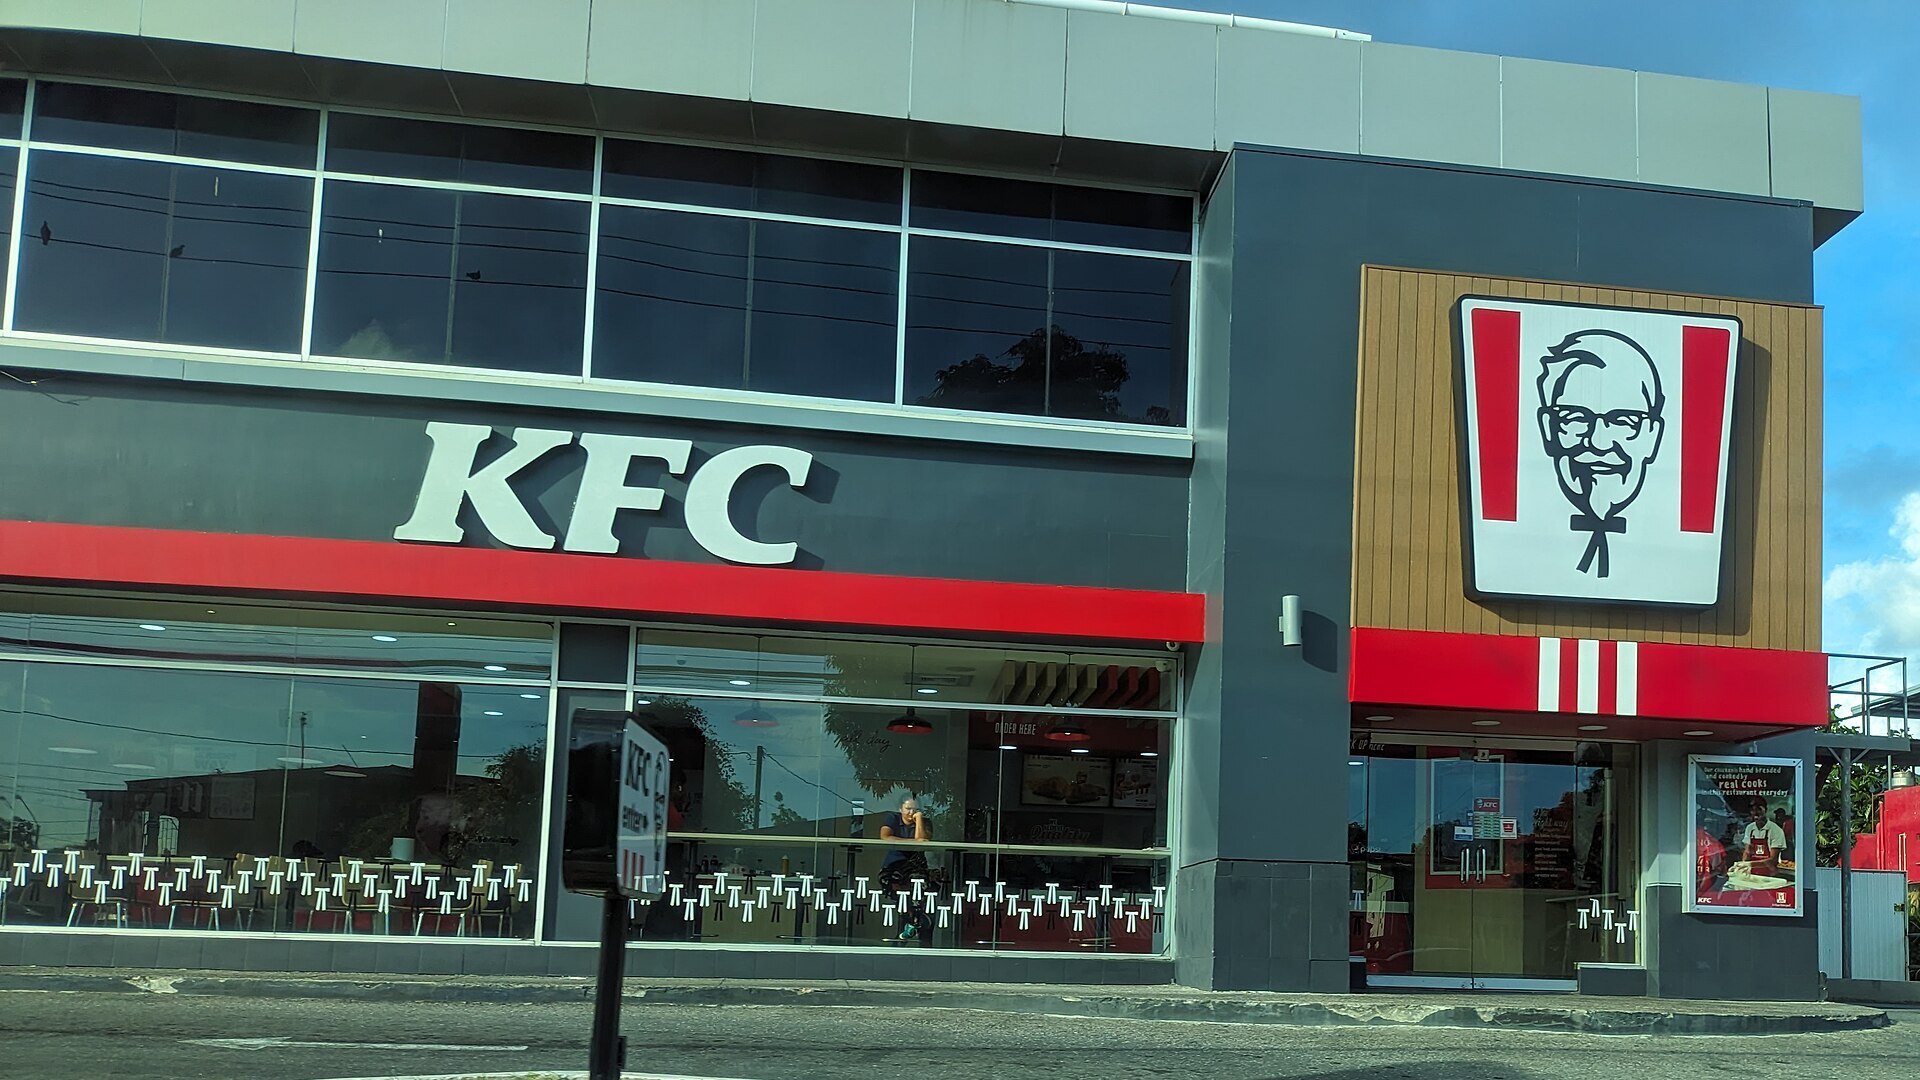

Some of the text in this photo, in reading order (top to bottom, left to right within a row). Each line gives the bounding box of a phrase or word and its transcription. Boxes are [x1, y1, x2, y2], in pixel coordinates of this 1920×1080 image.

[394, 422, 813, 565] KFC
[994, 722, 1017, 734] ODER
[625, 739, 653, 797] KFC
[1719, 779, 1767, 789] real cooks
[1758, 789, 1788, 797] everyday
